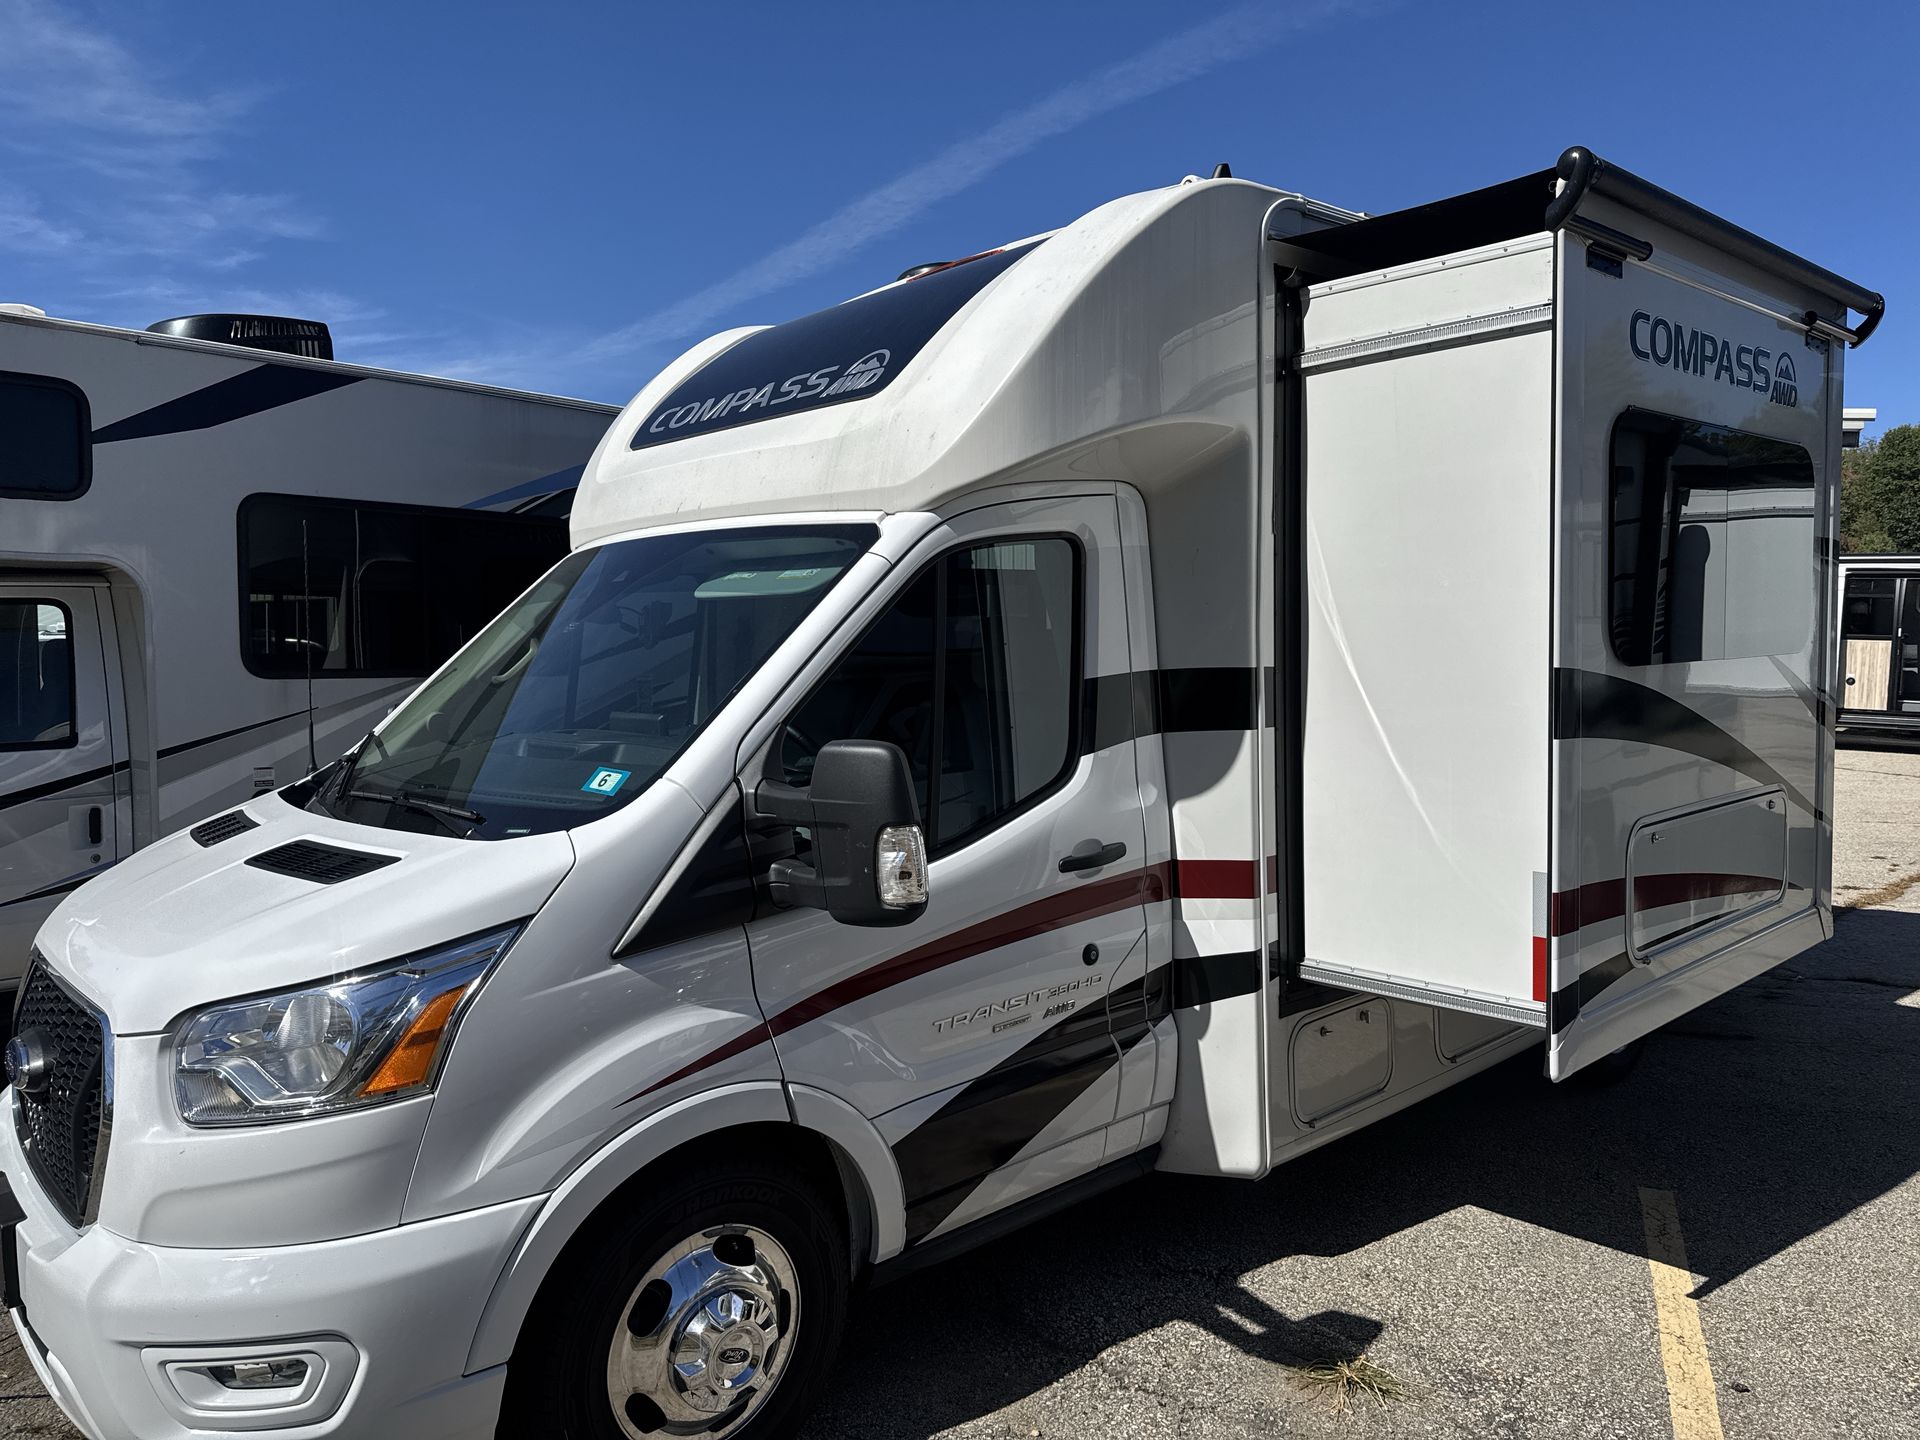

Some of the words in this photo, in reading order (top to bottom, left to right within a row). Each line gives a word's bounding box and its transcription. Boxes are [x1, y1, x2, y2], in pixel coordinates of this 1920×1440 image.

[1629, 309, 1771, 393] COMPASS
[1770, 380, 1798, 408] AWD
[649, 364, 840, 433] COMPASS
[822, 367, 885, 398] AWD
[597, 773, 612, 788] 6
[932, 989, 1048, 1033] TRANSIT
